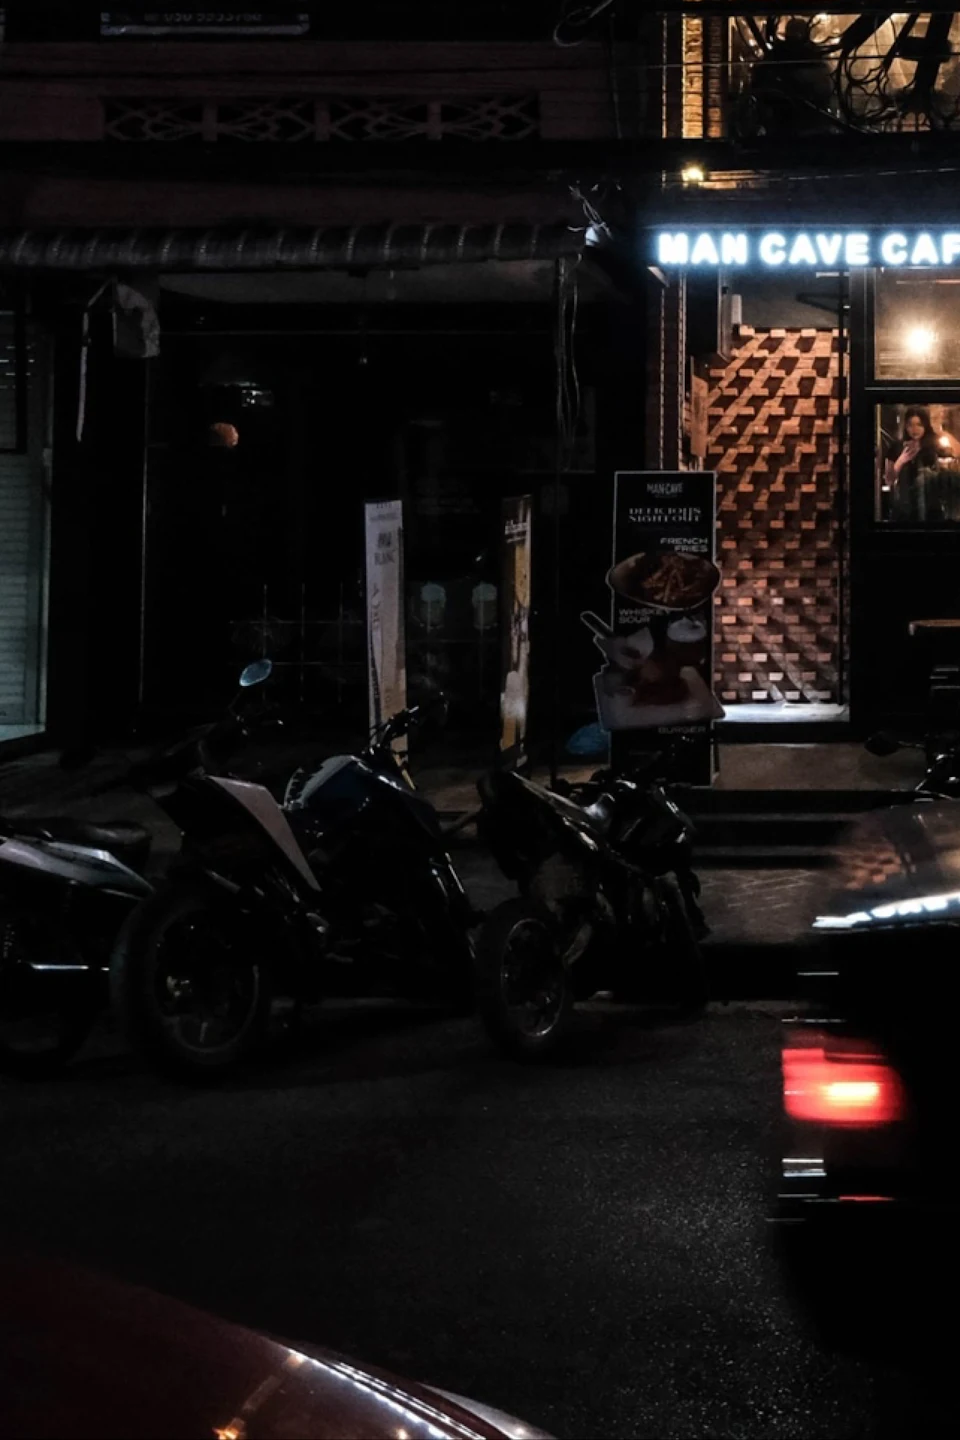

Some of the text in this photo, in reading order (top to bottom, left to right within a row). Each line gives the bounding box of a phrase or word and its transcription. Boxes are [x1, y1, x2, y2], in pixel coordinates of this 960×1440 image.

[658, 231, 749, 265] MAN
[758, 231, 871, 265] CAVE
[659, 537, 709, 545] FRENCH
[674, 545, 709, 553] FRIES
